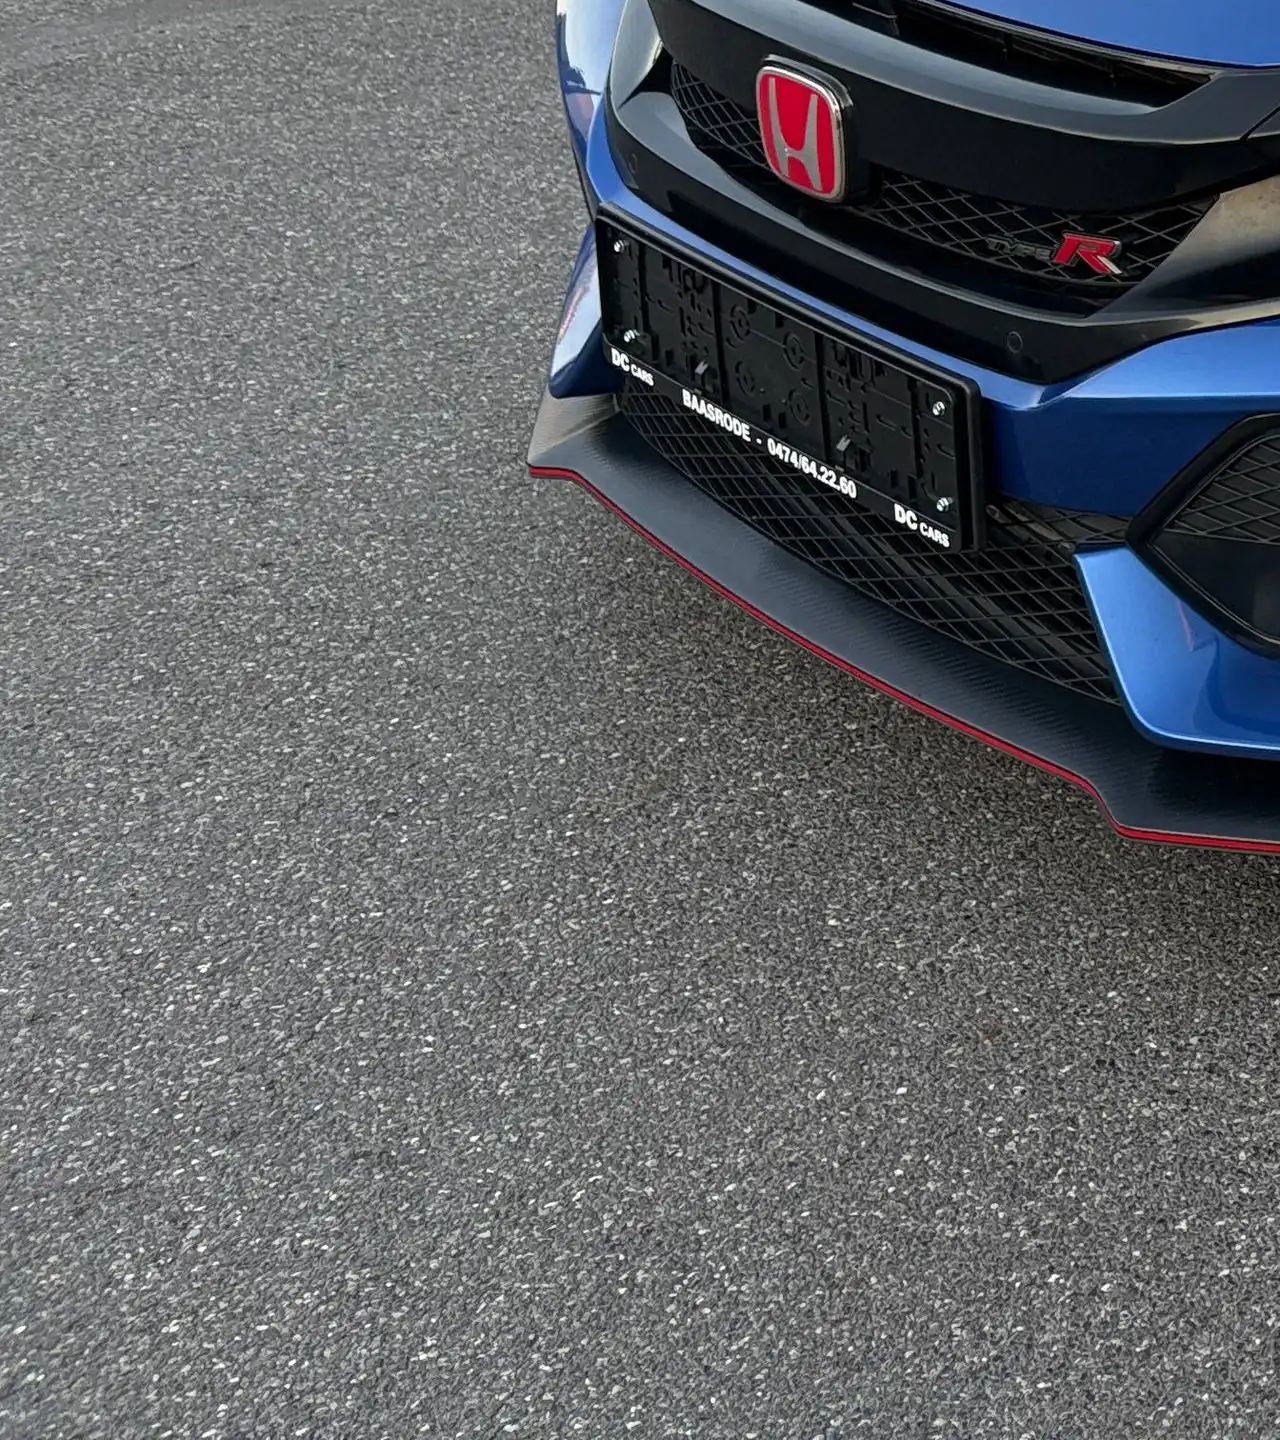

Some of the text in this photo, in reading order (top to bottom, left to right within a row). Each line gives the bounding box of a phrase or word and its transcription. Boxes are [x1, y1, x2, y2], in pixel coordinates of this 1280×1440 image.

[1052, 229, 1126, 275] R
[611, 347, 630, 372] DC
[630, 364, 654, 386] CARS
[682, 388, 751, 442] BAASRODE
[767, 437, 857, 499] 0474/64.22.60
[894, 503, 918, 530] DC
[919, 523, 950, 548] CARS
